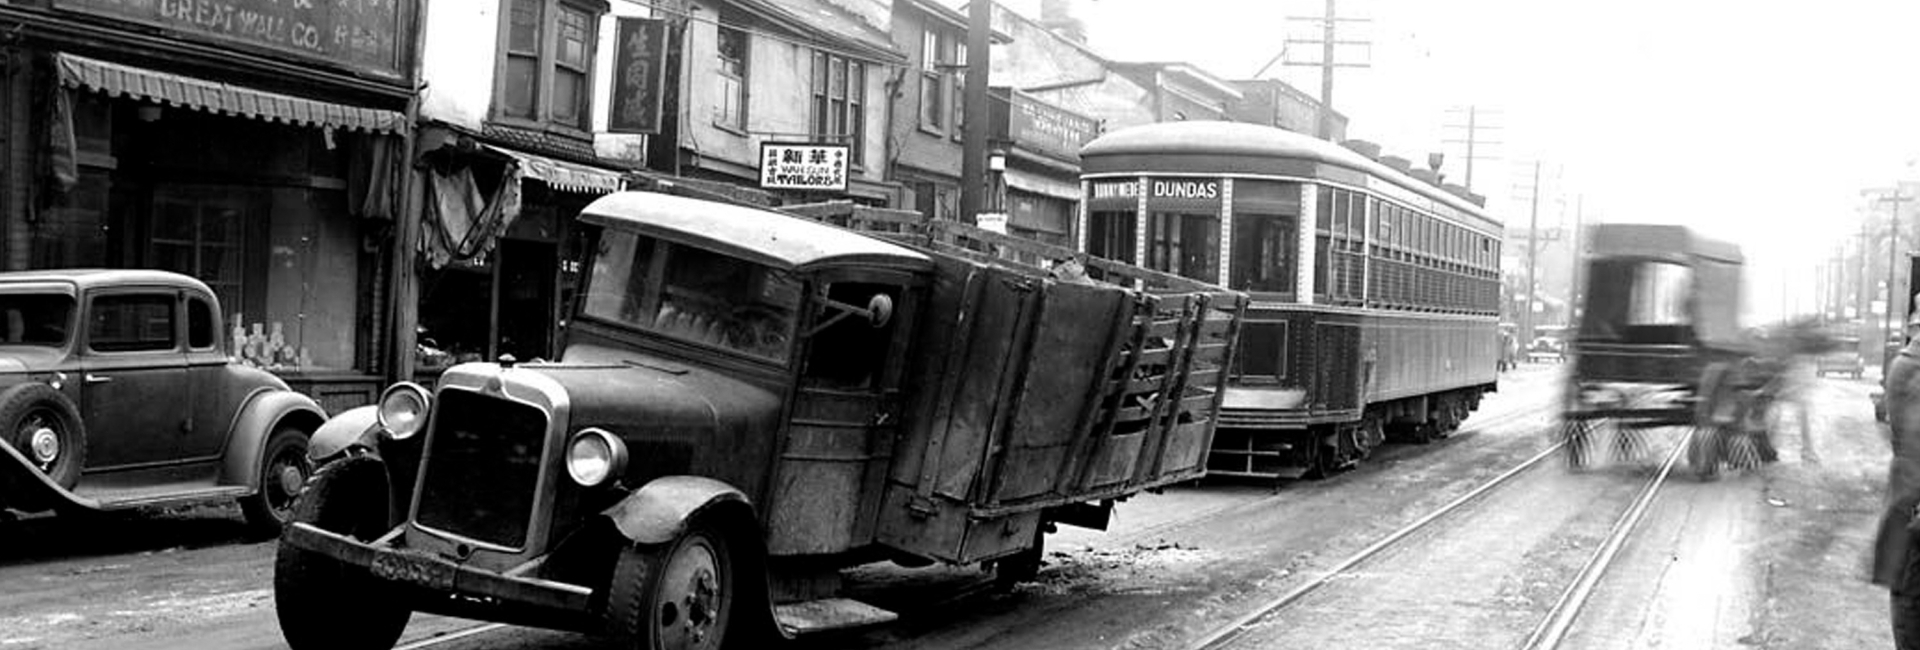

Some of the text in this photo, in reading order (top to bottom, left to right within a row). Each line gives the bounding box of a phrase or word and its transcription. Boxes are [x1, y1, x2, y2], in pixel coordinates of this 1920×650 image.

[160, 0, 235, 31] GREAT
[240, 9, 285, 42] WALL
[291, 21, 323, 52] CO.
[776, 174, 834, 186] TAILORS
[1154, 181, 1217, 199] DUNDAS
